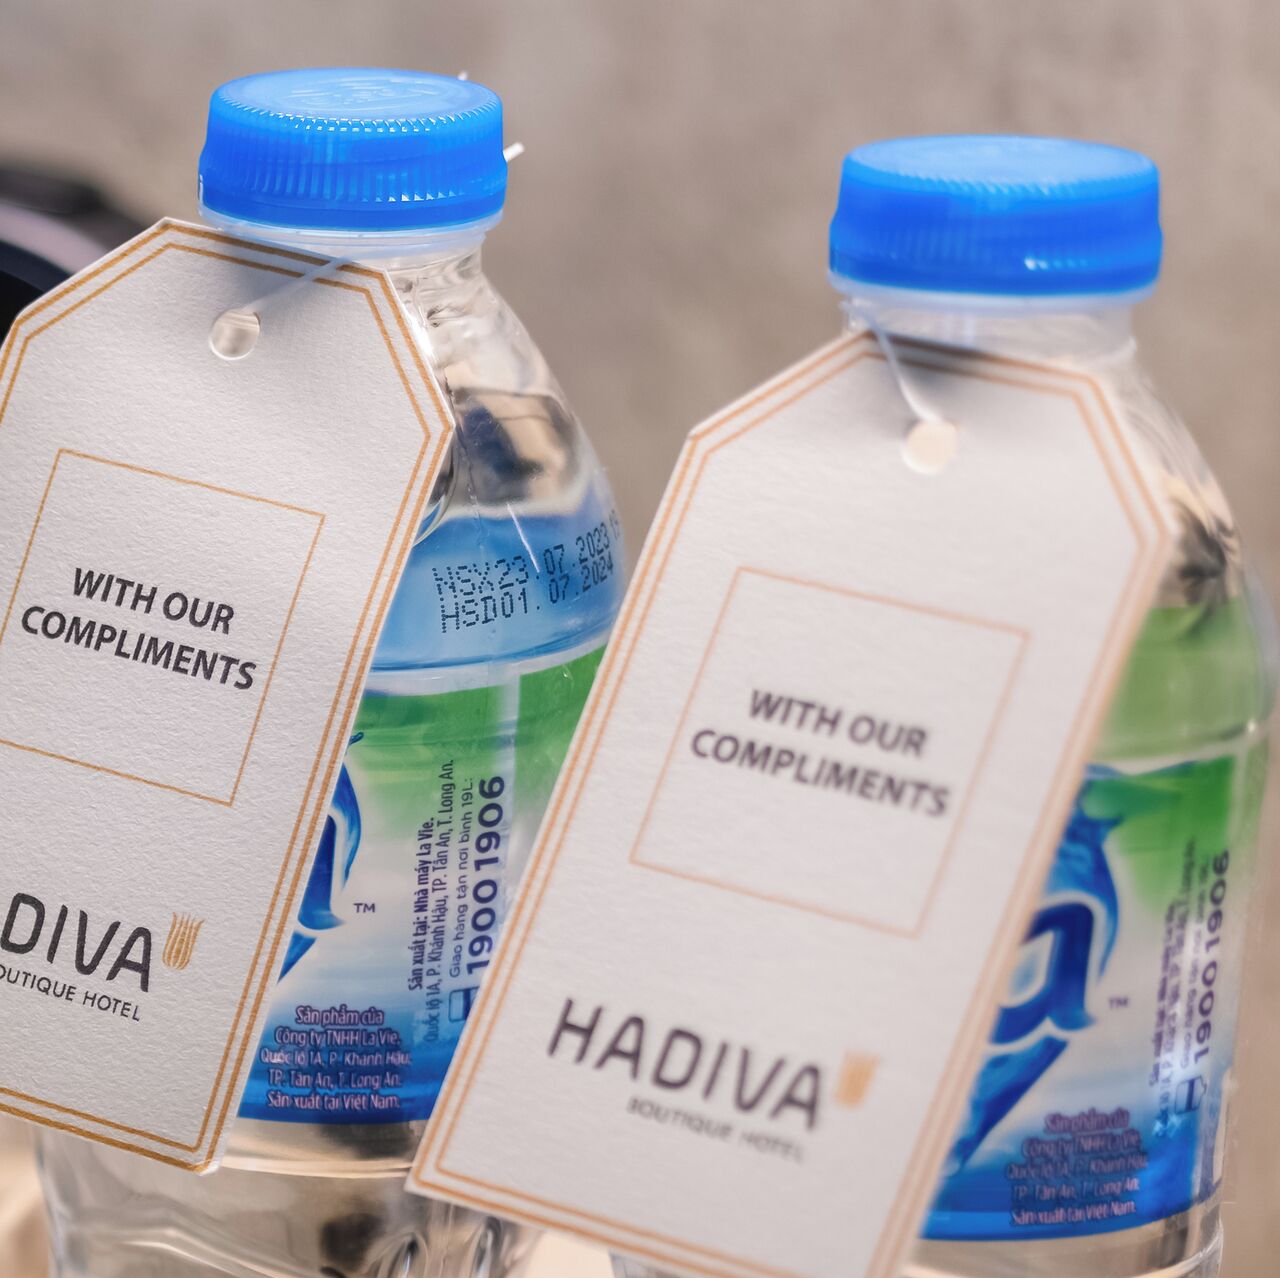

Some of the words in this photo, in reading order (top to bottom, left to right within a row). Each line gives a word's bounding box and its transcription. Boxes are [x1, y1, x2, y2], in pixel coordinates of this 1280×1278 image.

[73, 567, 157, 614] WITH
[162, 592, 234, 635] OUR
[21, 605, 257, 690] COMPLIMENTS
[749, 689, 842, 737] WITH
[848, 715, 928, 758] OUR
[438, 783, 456, 813] Long
[691, 729, 949, 817] COMPLIMENTS
[416, 843, 431, 856] La
[474, 776, 505, 872] 1906
[466, 879, 498, 975] 1900
[1205, 851, 1229, 952] 1906
[83, 990, 141, 1022] HOTEL
[325, 1030, 359, 1045] TNHH
[361, 1031, 375, 1045] La
[1194, 960, 1217, 1064] 1900
[547, 997, 820, 1132] HADIVA
[626, 1097, 733, 1142] BOUTIQUE
